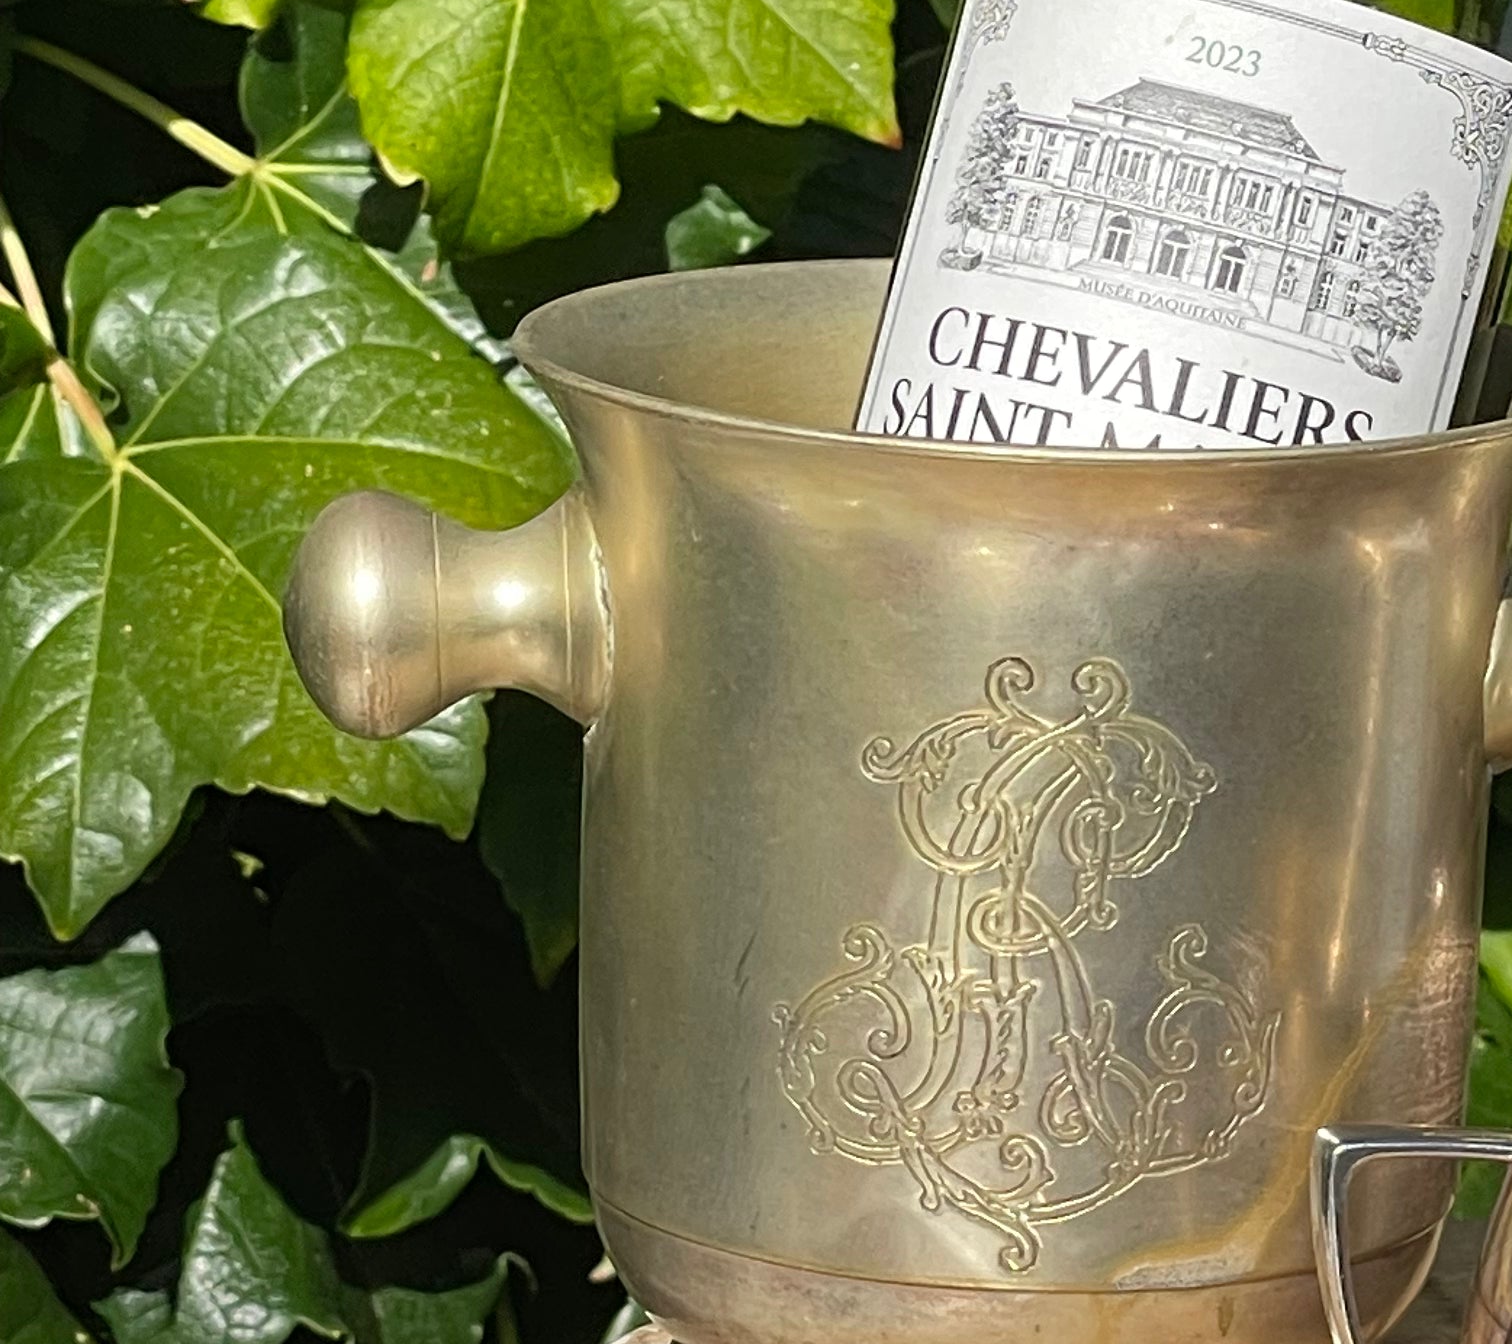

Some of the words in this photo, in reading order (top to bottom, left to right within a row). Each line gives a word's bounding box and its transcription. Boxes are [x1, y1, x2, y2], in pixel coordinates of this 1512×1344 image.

[1185, 35, 1262, 77] 2023
[1078, 277, 1135, 300] MUSÉE
[1137, 290, 1248, 331] D'AQUITAINE
[928, 305, 1374, 447] CHEVALIERS
[883, 378, 1073, 447] SAINT
